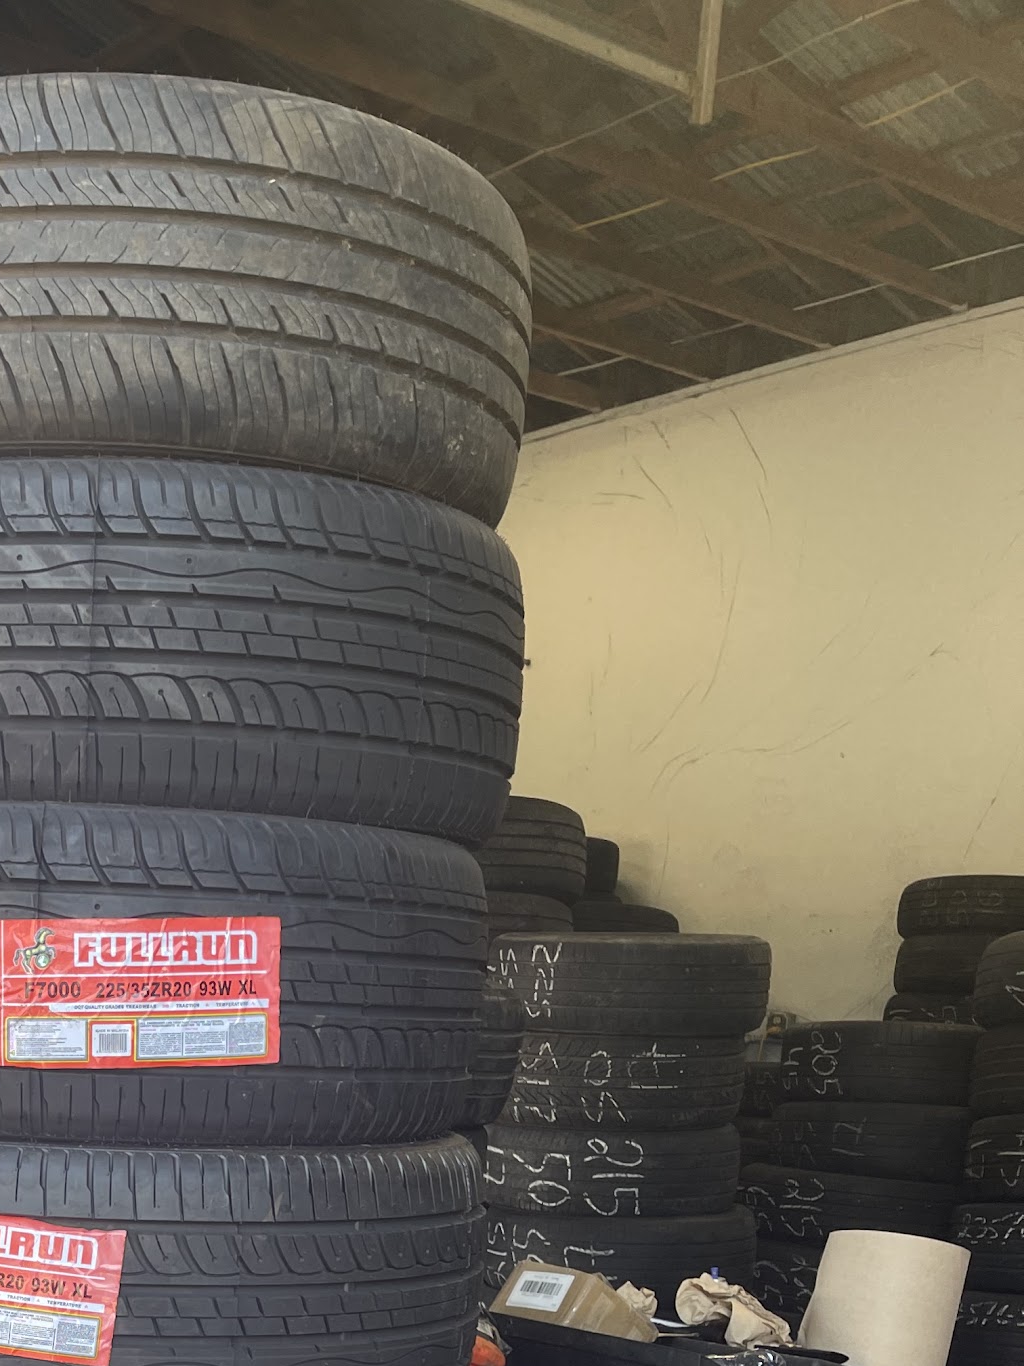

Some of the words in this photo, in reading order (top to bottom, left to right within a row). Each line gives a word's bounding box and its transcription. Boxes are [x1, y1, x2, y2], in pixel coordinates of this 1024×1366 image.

[74, 930, 257, 968] FULLRUN
[24, 981, 81, 999] F7000
[95, 980, 192, 999] 225/35ZR20
[199, 979, 232, 996] 93W
[238, 979, 257, 996] XL
[807, 1030, 843, 1096] 205
[583, 1137, 644, 1215] 215
[30, 1276, 66, 1297] 93W
[71, 1281, 93, 1299] XL
[47, 1300, 82, 1309] TEMPERATURE
